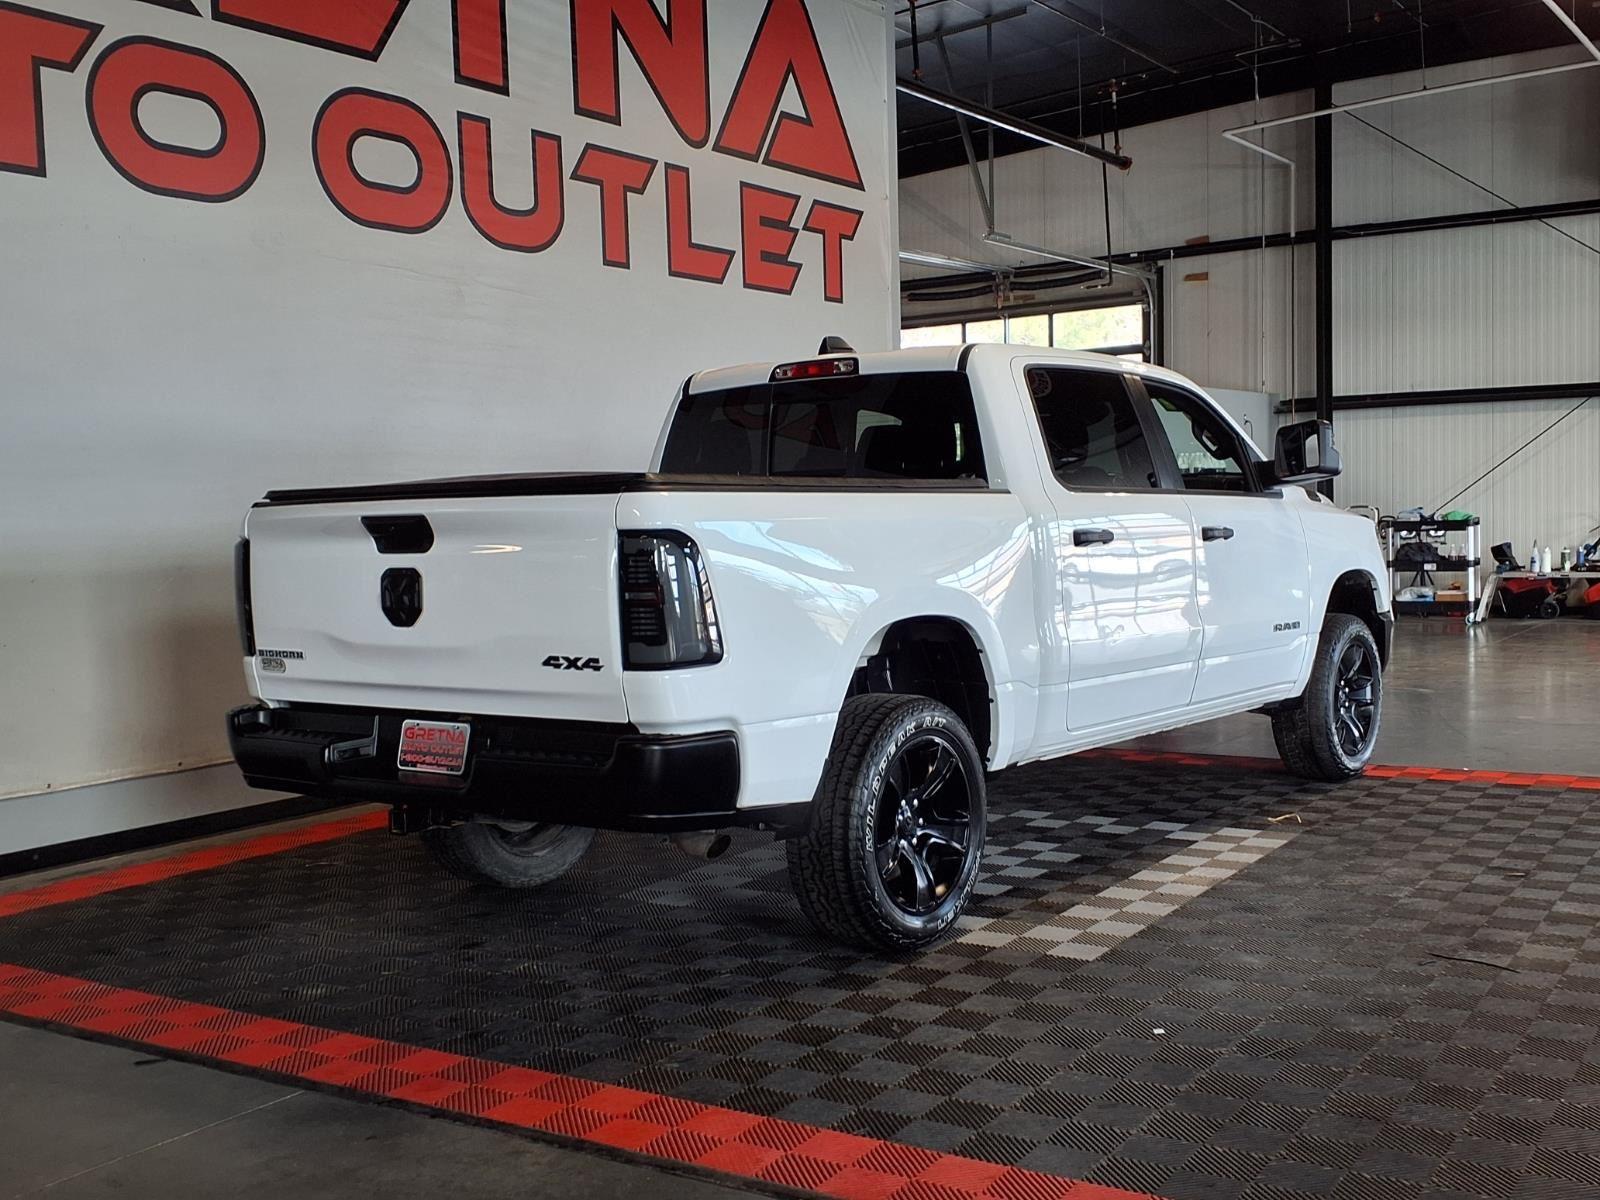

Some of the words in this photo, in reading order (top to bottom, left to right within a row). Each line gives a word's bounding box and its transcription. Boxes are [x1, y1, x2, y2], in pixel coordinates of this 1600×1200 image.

[312, 87, 864, 303] OUTLET
[1273, 621, 1301, 633] RAM
[405, 727, 465, 743] GRETNA
[431, 744, 464, 755] OUTLET
